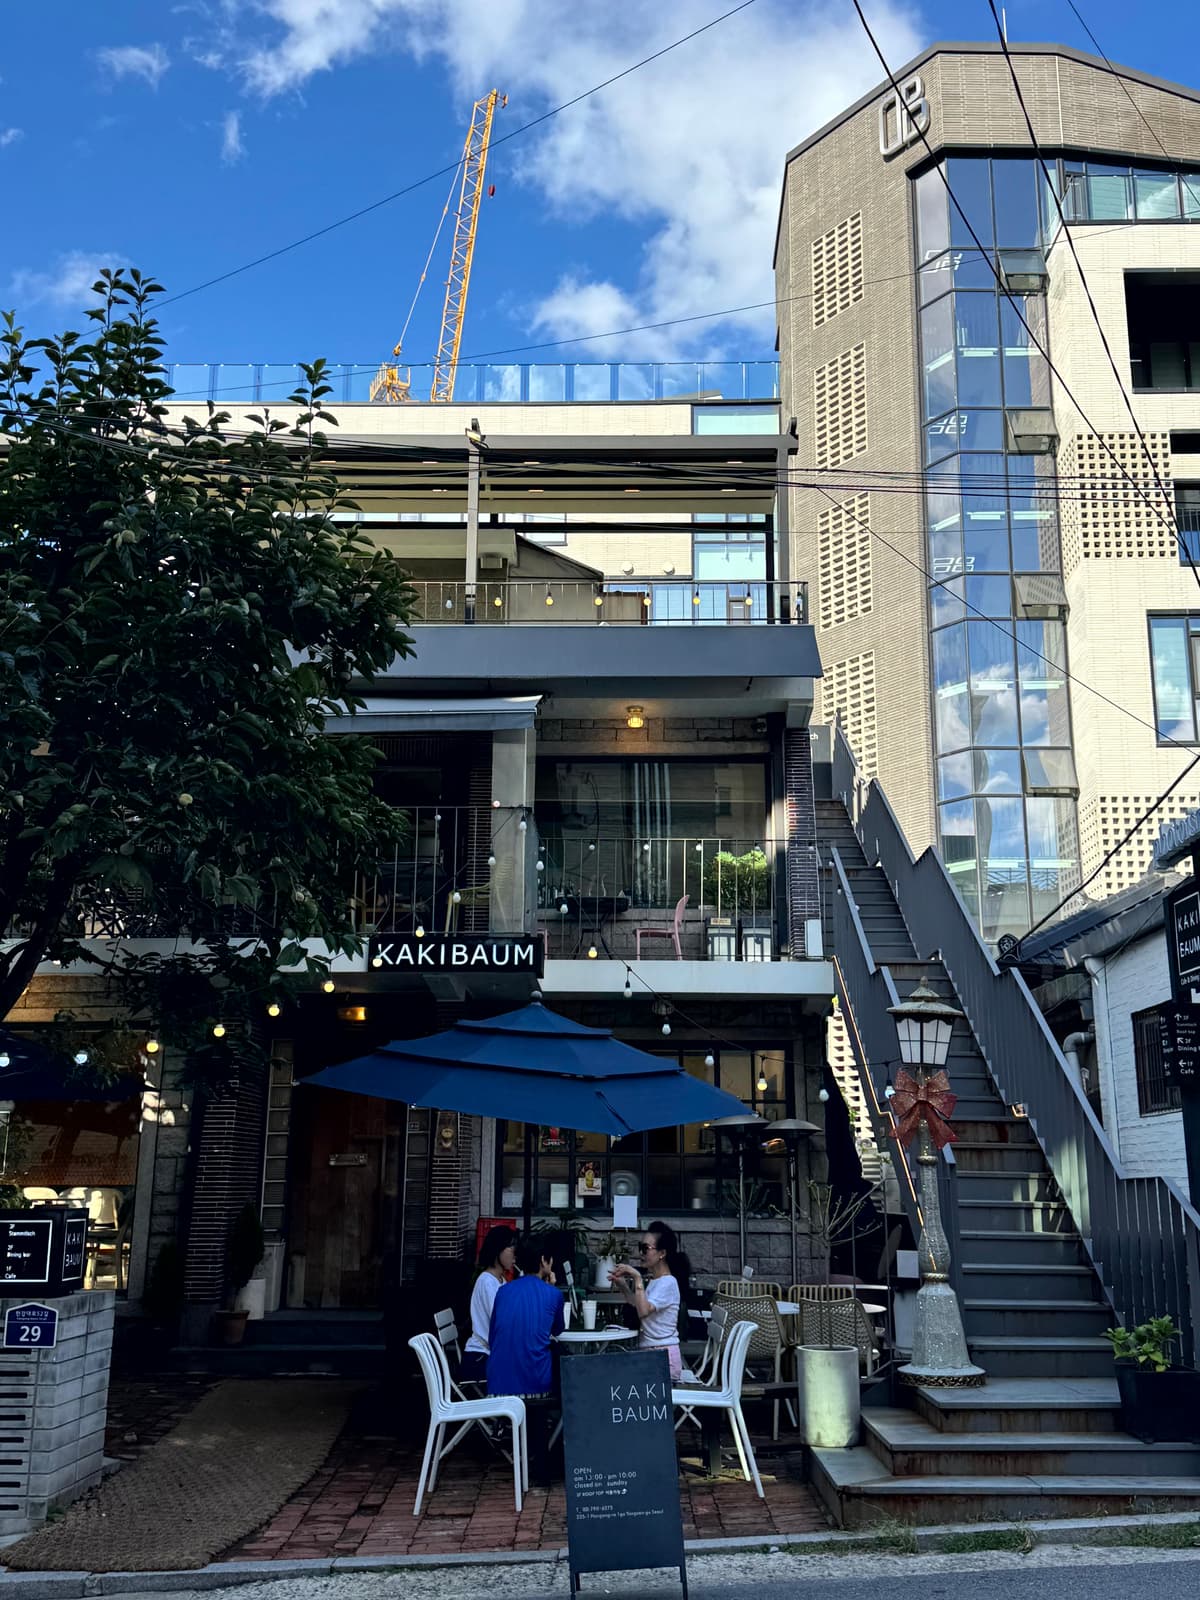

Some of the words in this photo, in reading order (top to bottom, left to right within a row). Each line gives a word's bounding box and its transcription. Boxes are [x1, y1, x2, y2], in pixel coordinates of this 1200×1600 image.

[1177, 910, 1199, 932] KAKI
[378, 943, 534, 966] KAKIBAUM
[1179, 936, 1200, 958] BAUM
[67, 1232, 83, 1245] KAKI
[20, 1325, 41, 1342] 29
[610, 1382, 666, 1401] KAKI
[612, 1404, 668, 1423] BAUM
[574, 1481, 594, 1489] closed
[607, 1479, 628, 1487] sunday
[618, 1471, 637, 1479] 10:00
